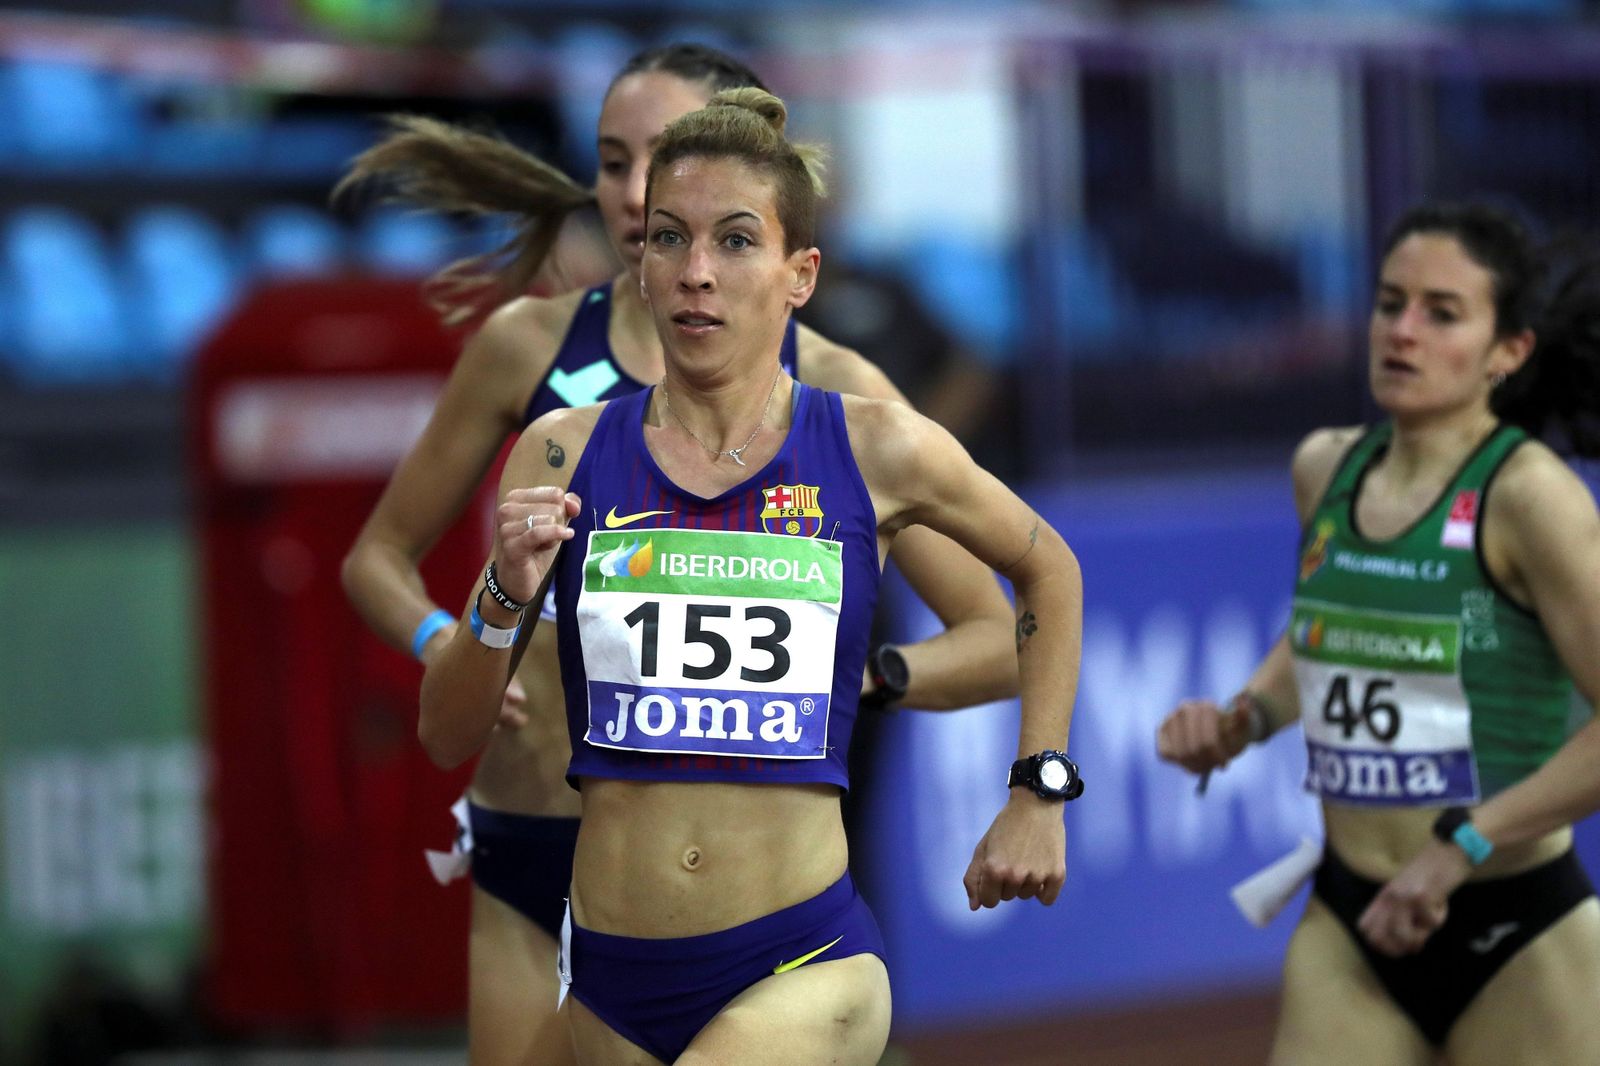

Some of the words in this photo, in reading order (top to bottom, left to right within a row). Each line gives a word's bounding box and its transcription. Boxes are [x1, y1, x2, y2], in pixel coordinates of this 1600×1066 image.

[779, 509, 805, 517] FCB
[660, 552, 826, 584] IBERDROLA
[487, 579, 498, 593] DO
[496, 592, 506, 602] IT
[623, 601, 793, 683] 153
[1323, 674, 1401, 742] 46
